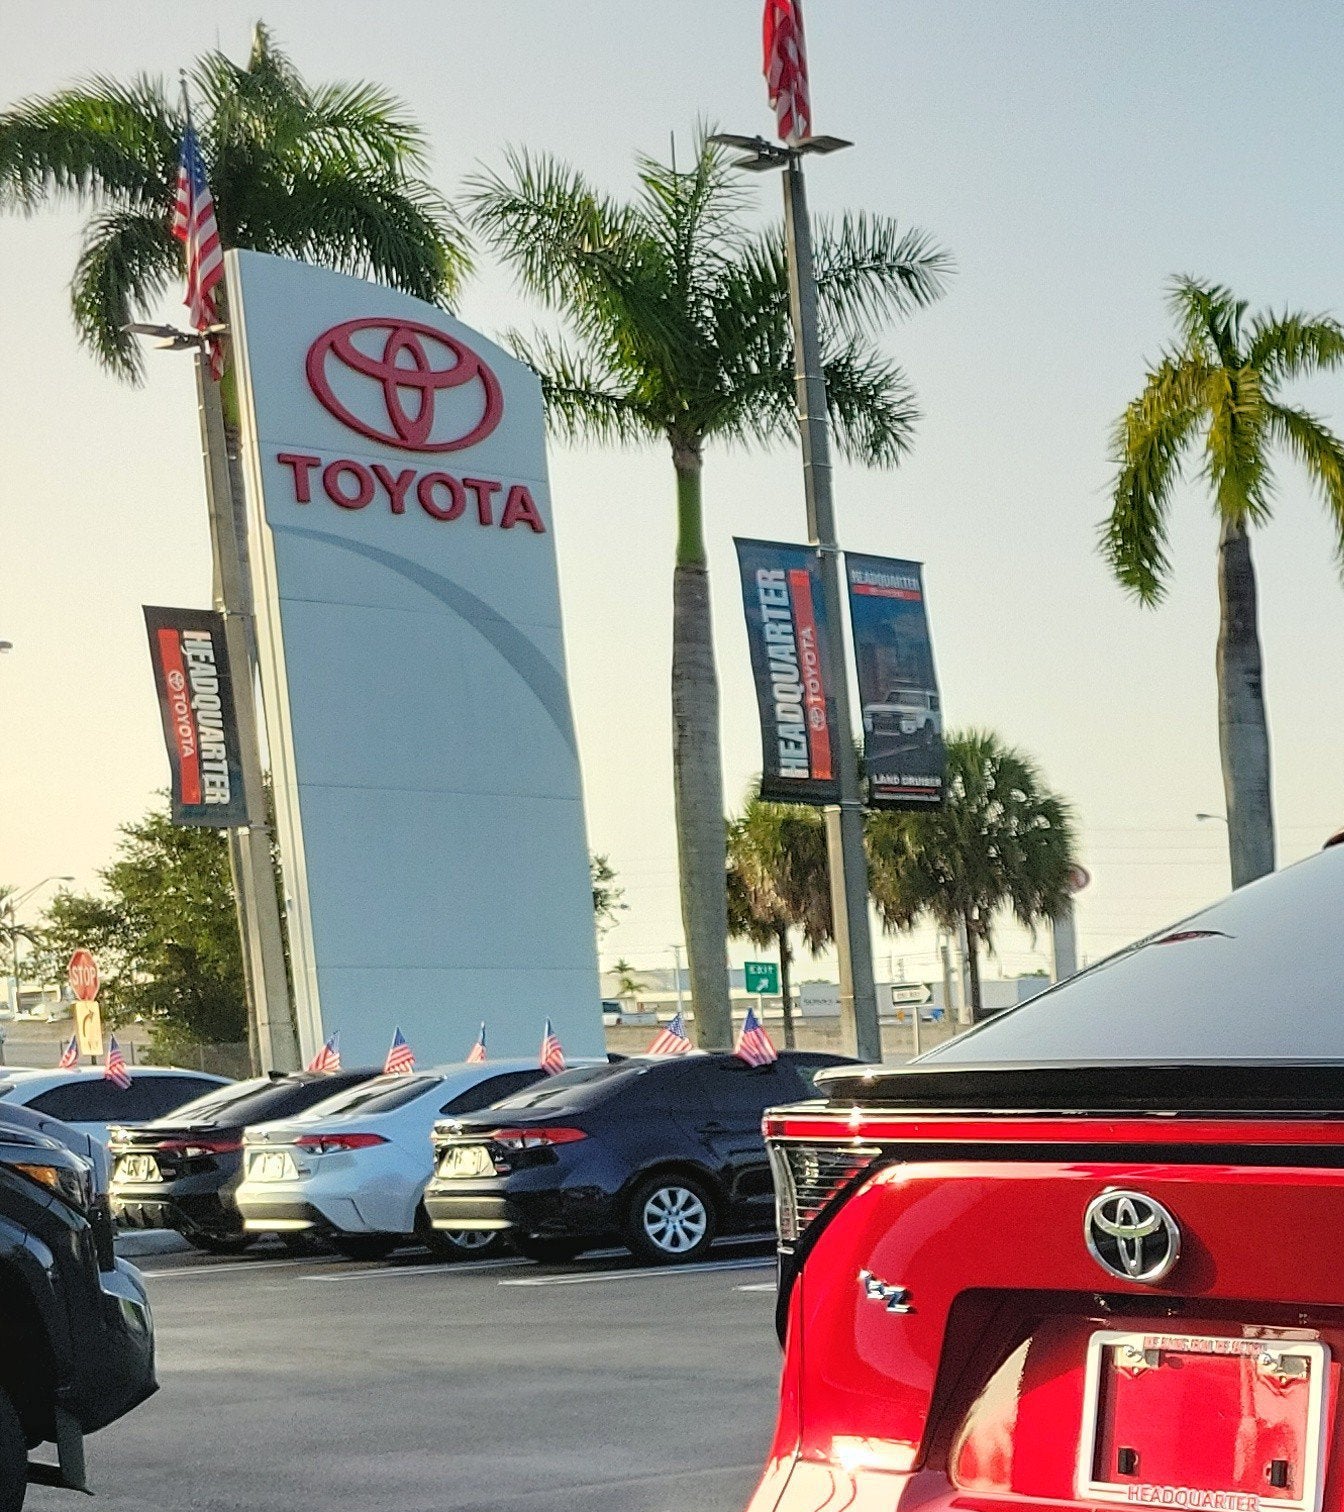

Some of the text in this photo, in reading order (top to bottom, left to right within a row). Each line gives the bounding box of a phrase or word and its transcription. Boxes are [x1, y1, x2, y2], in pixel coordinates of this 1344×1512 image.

[277, 453, 546, 533] TOYOTA
[757, 569, 809, 779] HEADQUARTER
[802, 628, 822, 703] TOYOTA
[173, 692, 194, 757] TOYOTA
[181, 630, 231, 805] HEADQUARTER
[72, 966, 97, 986] STOP
[1127, 1484, 1260, 1512] HEADQUARTER
